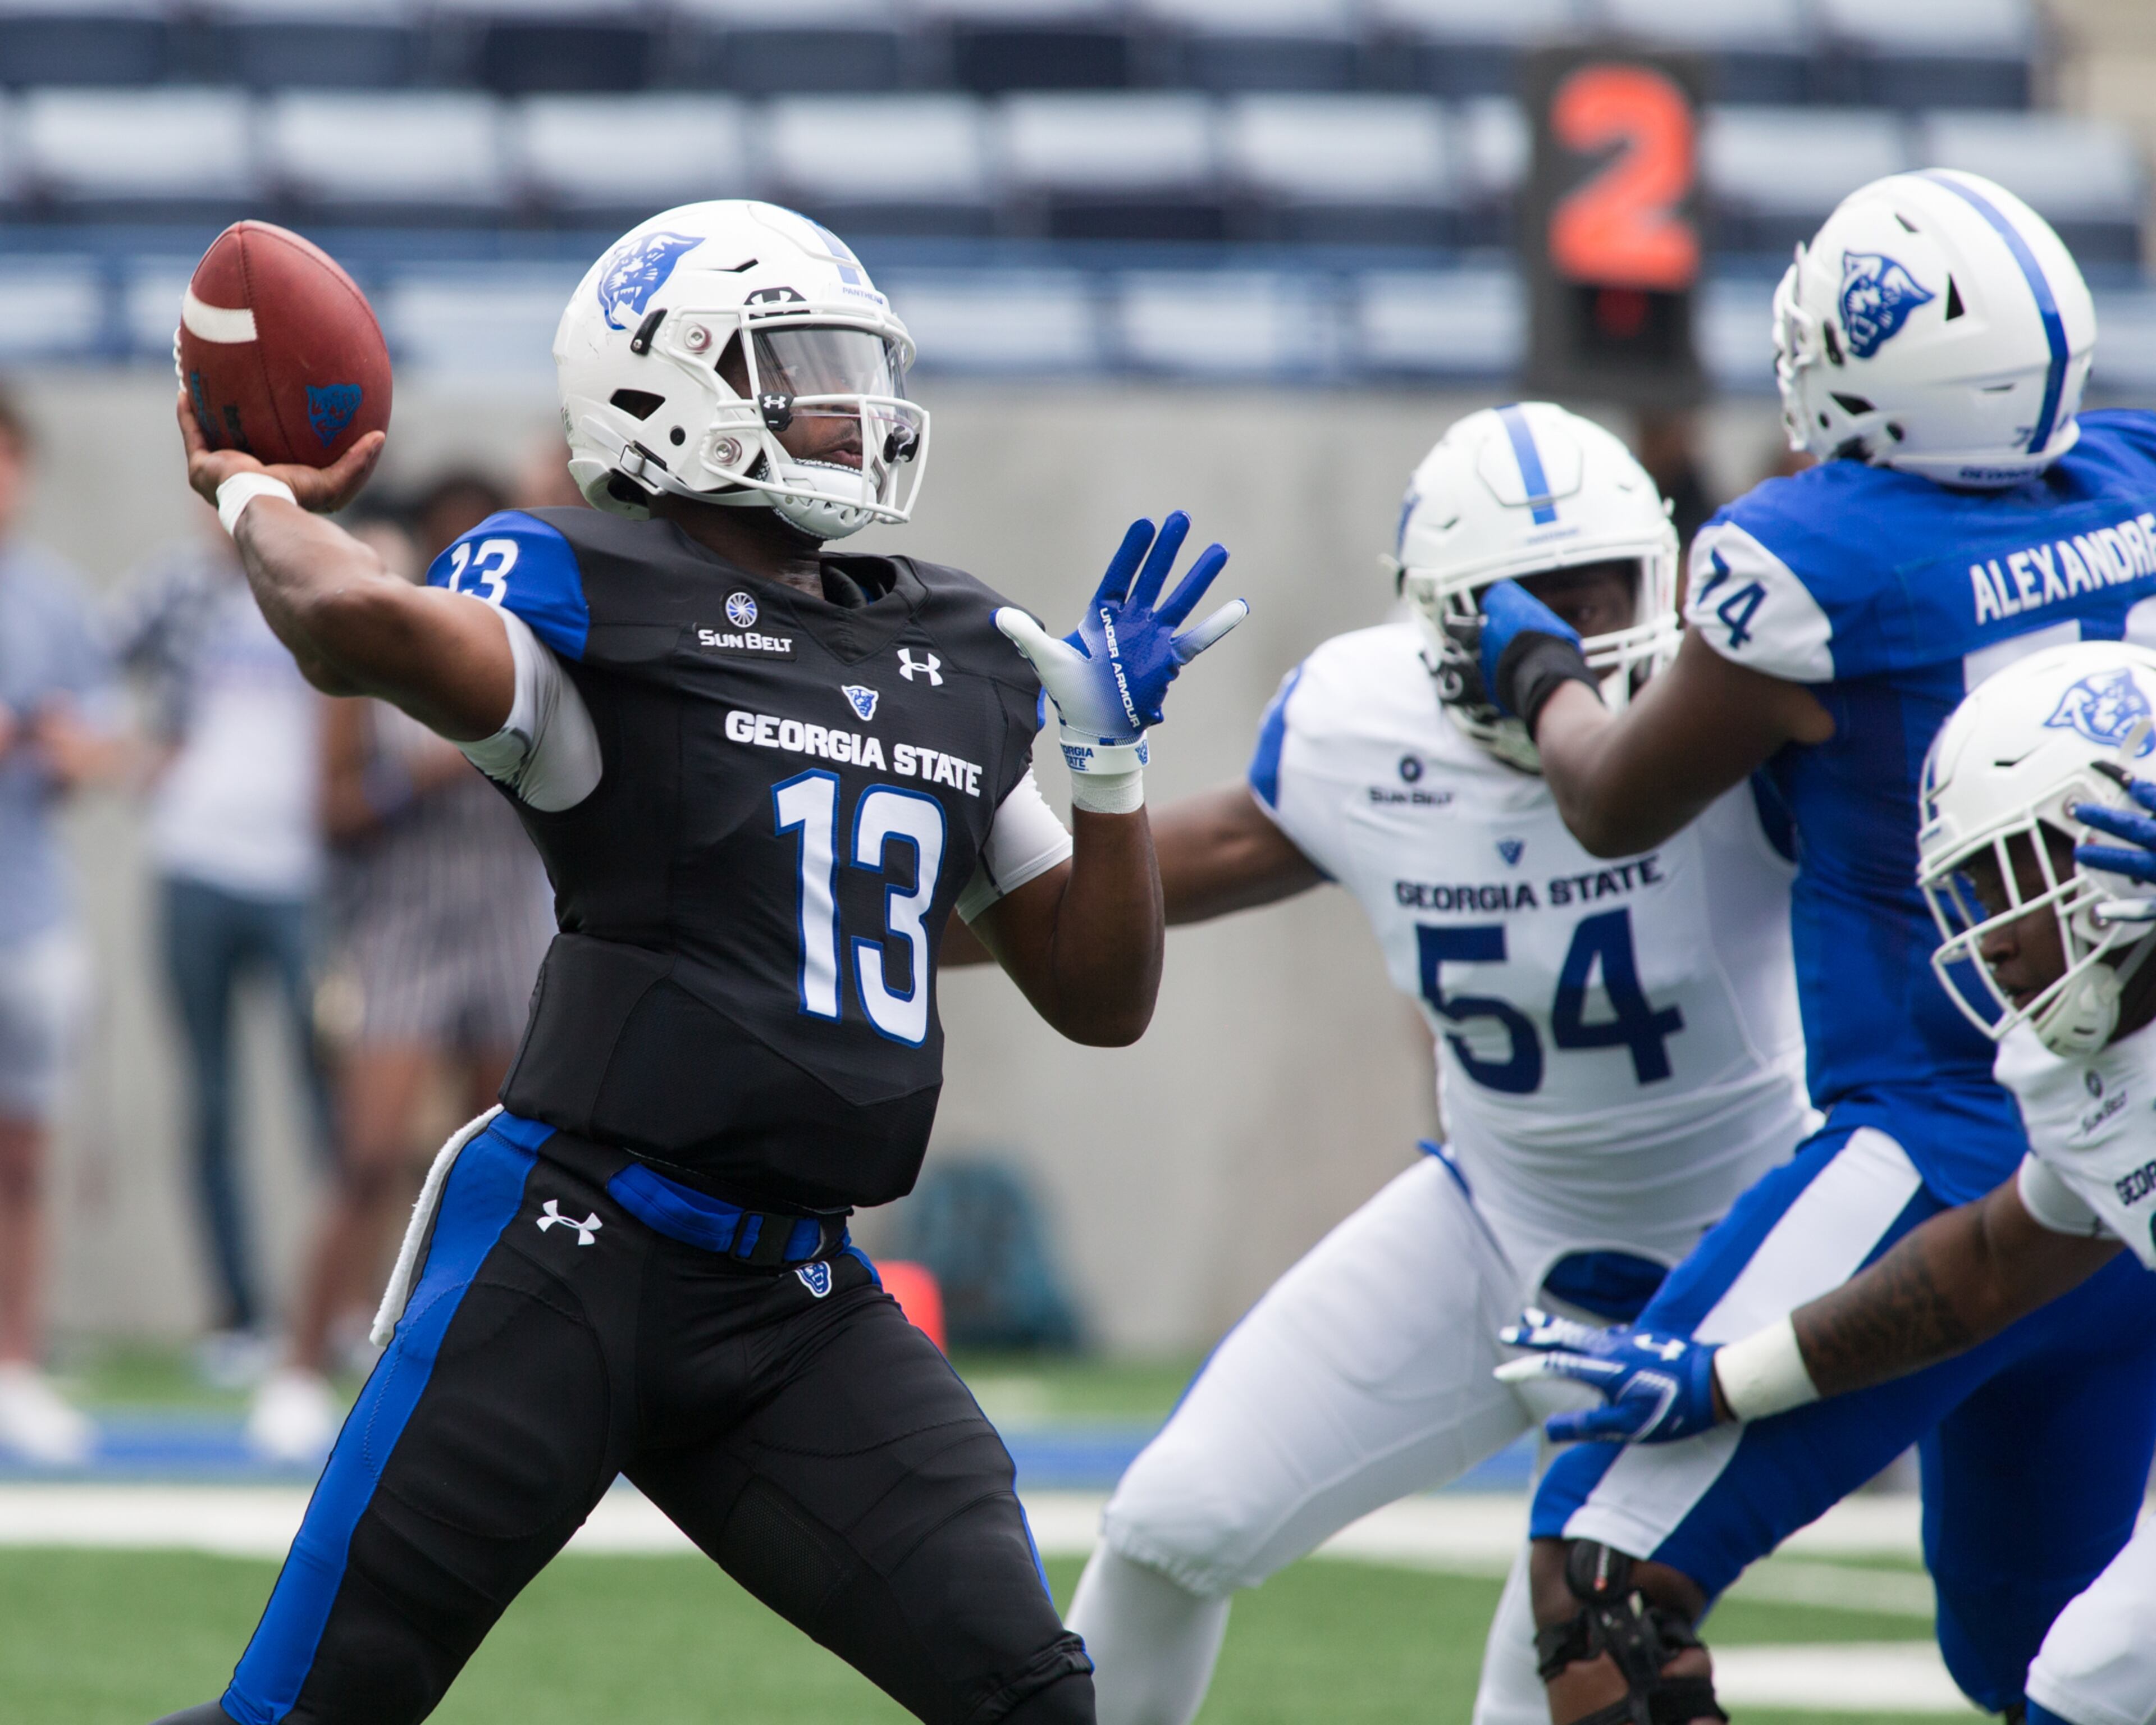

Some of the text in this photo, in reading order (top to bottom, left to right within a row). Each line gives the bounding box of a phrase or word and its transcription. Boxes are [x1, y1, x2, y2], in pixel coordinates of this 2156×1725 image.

[1549, 65, 1699, 288] 2
[449, 539, 519, 606] 13
[1696, 545, 1767, 651] 74
[698, 629, 793, 652] SUN BELT
[1100, 607, 1141, 728] UNDER ARMOUR
[725, 710, 983, 798] GEORGIA STATE
[1065, 755, 1086, 768] TATE
[770, 767, 948, 1049] 13
[1395, 854, 1663, 912] GEORGIA STATE
[1414, 903, 1686, 1095] 54
